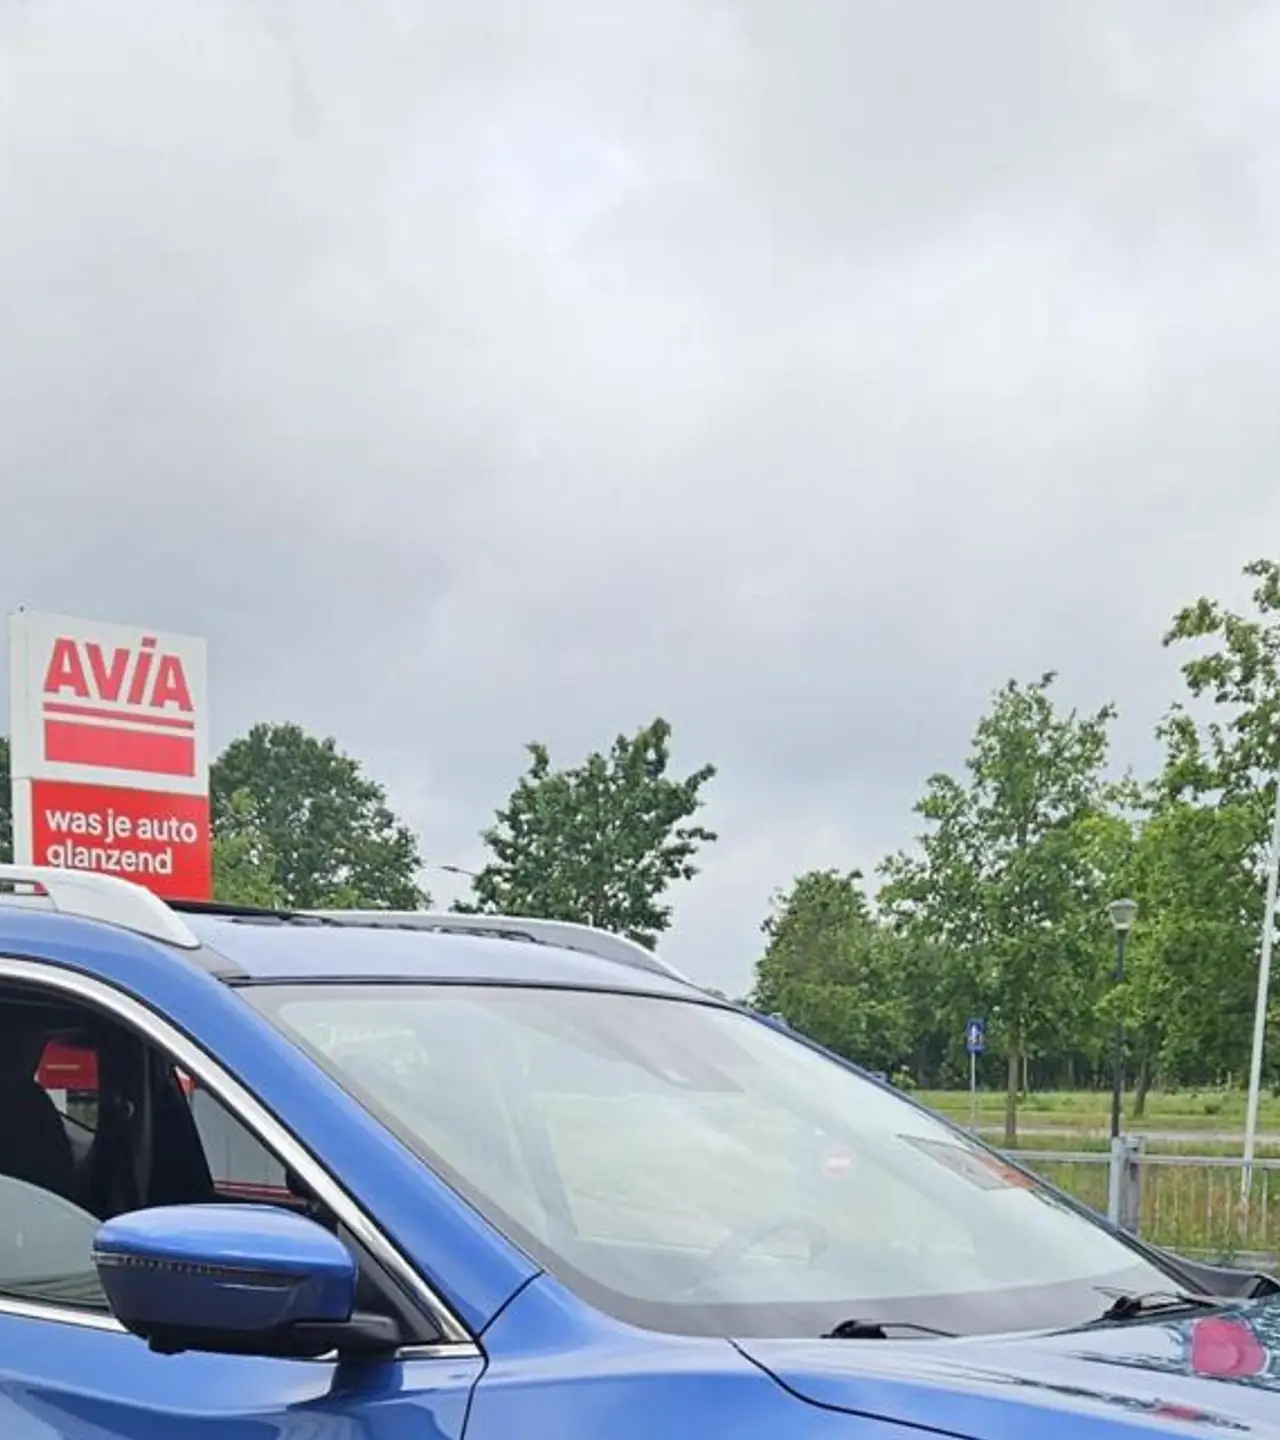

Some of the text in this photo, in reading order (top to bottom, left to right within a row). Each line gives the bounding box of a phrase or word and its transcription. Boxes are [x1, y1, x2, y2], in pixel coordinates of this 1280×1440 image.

[45, 808, 198, 843] was je auto
[46, 839, 173, 875] glanzend
